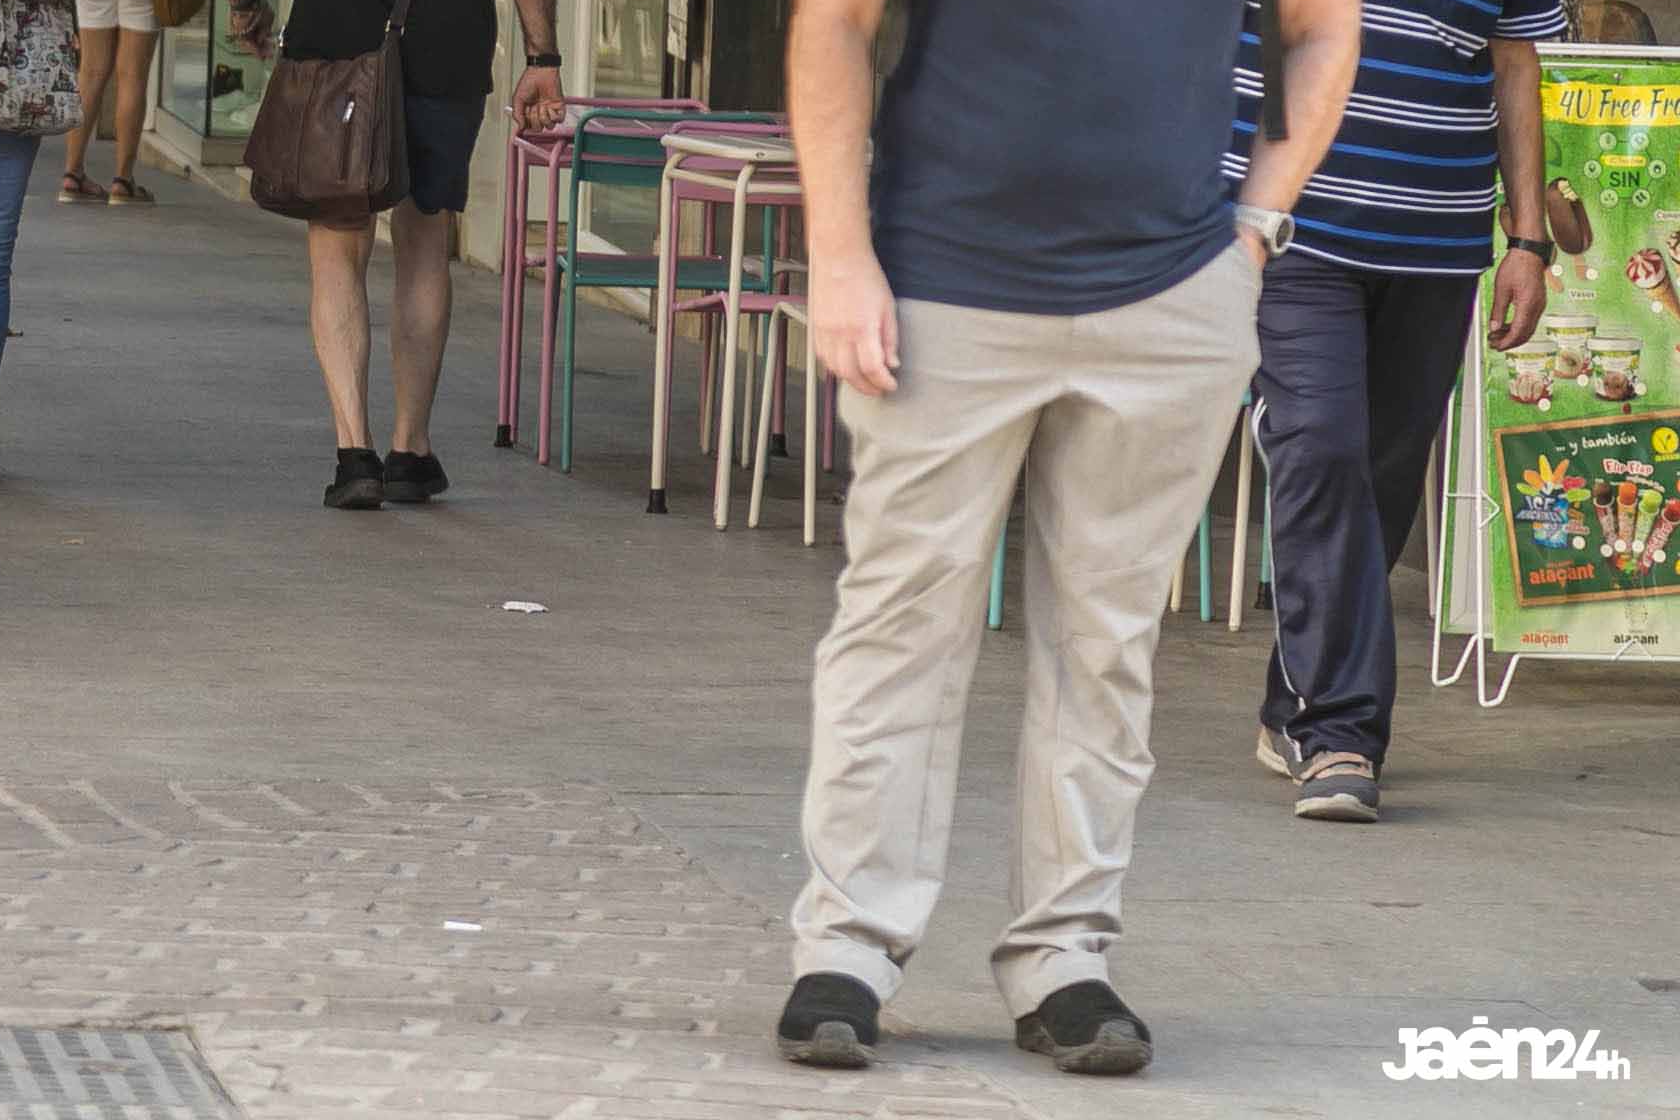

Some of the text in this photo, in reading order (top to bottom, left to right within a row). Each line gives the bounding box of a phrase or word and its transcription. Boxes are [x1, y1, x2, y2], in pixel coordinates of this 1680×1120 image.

[1560, 88, 1593, 121] 4U
[1599, 89, 1641, 119] Free
[1609, 171, 1640, 188] SIN
[1569, 442, 1578, 455] y
[1582, 432, 1637, 449] también
